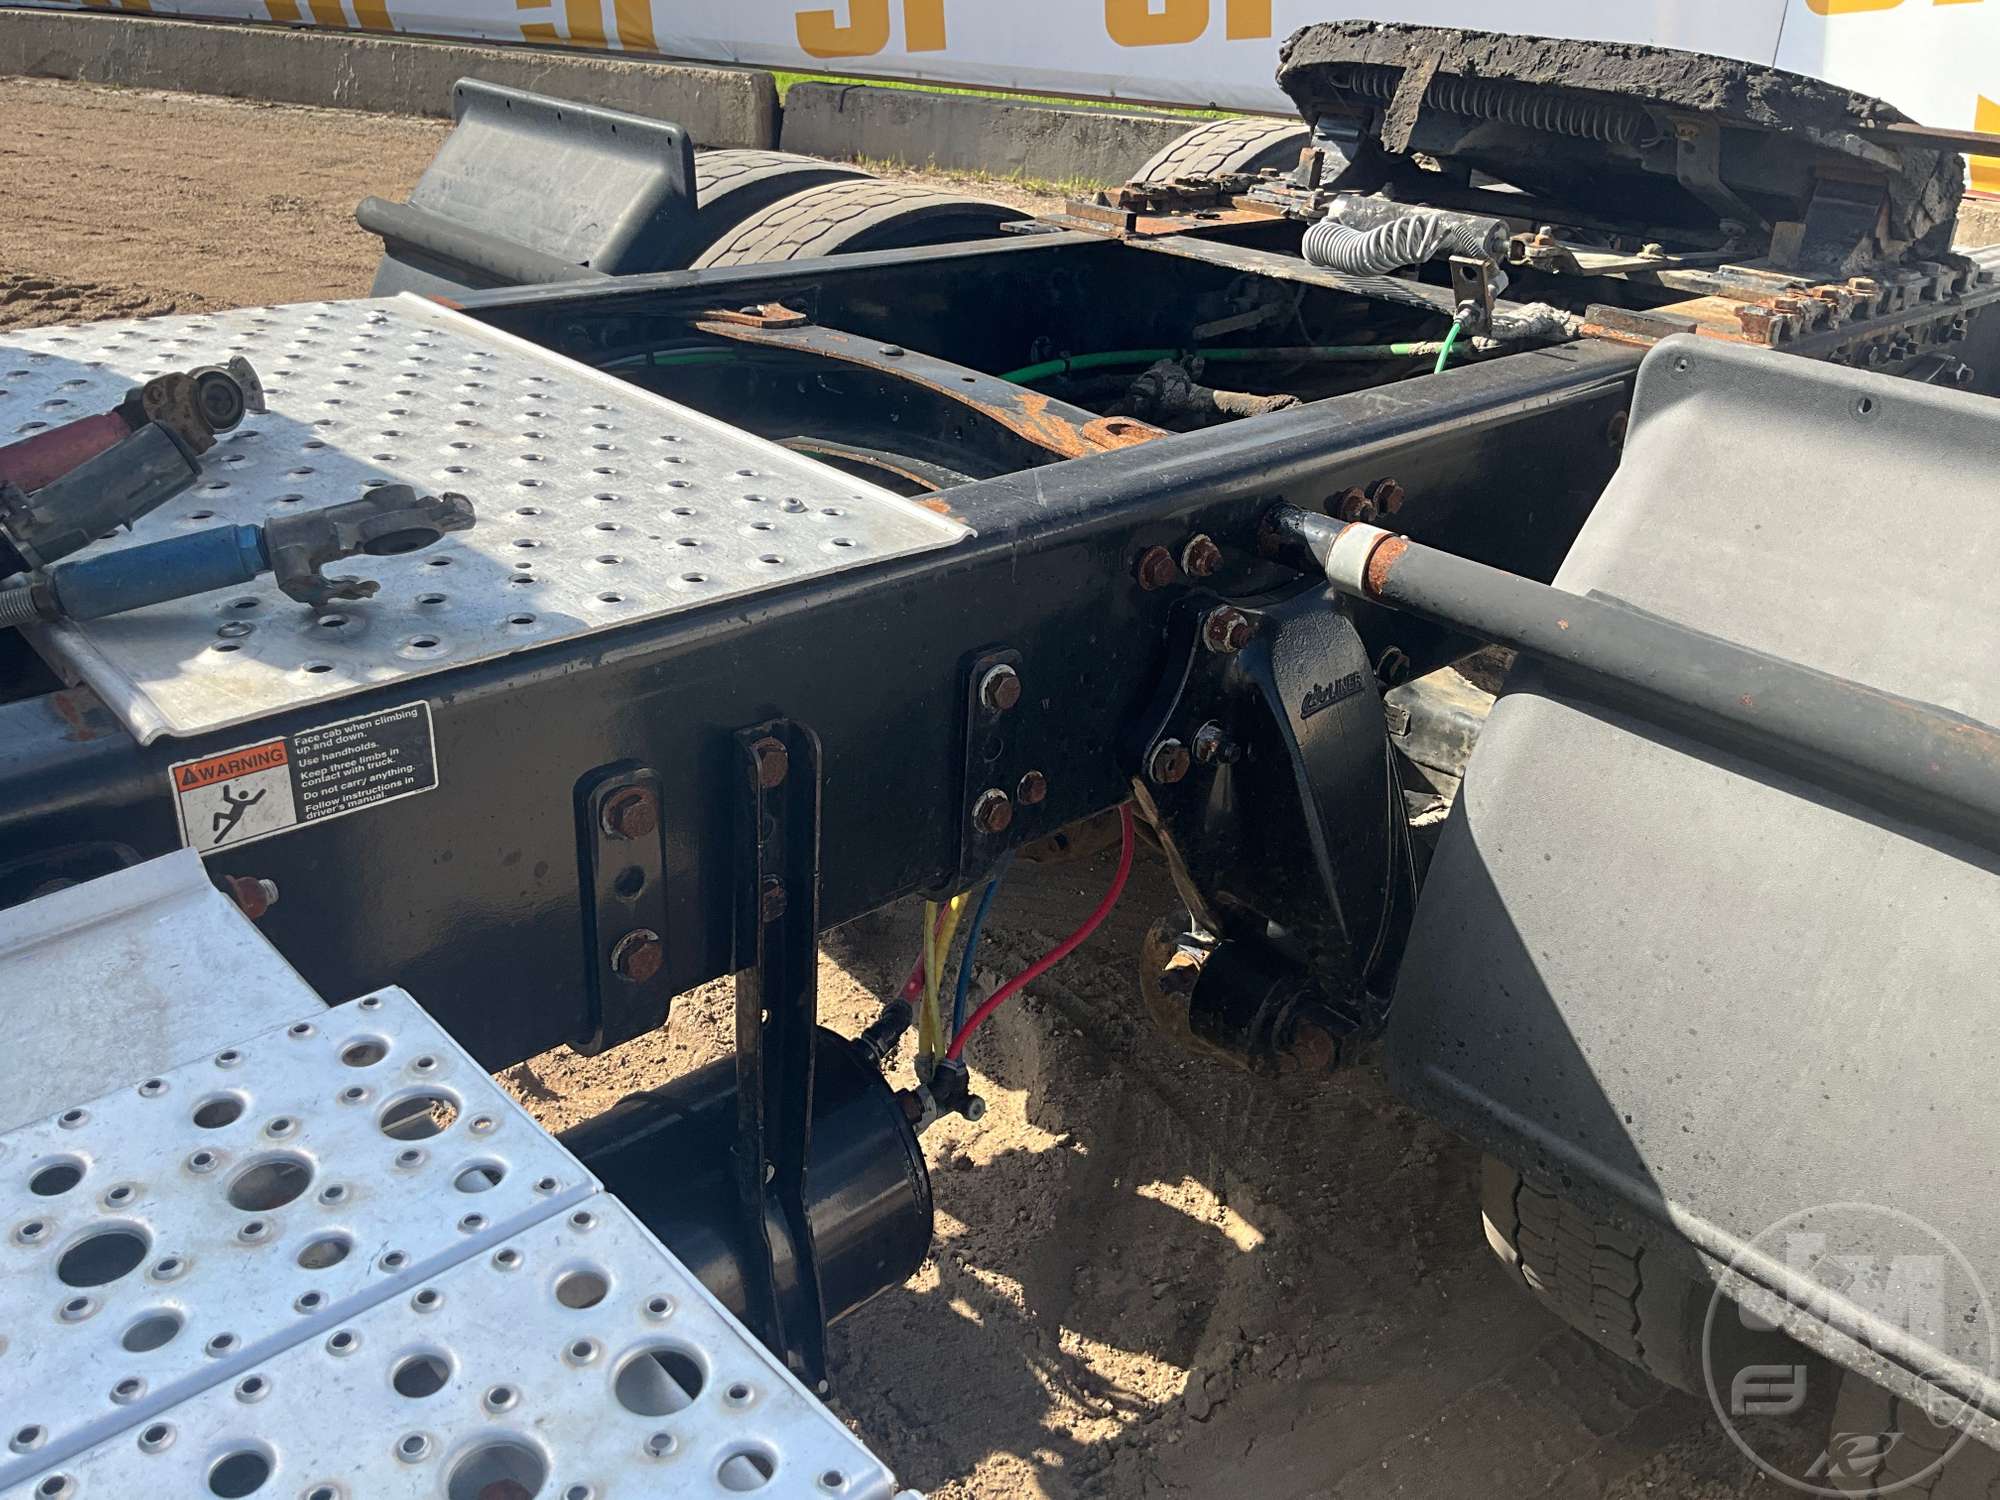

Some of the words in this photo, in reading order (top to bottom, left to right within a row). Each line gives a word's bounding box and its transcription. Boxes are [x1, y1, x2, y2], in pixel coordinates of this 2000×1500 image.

[294, 734, 320, 746] Face
[322, 727, 342, 739] cab
[344, 720, 373, 733] when
[374, 709, 418, 726] climbing
[296, 745, 311, 755] up
[313, 739, 333, 750] and
[335, 731, 368, 743] down.
[198, 748, 284, 777] WARNING
[298, 756, 319, 768] Use
[322, 741, 379, 760] handholds.
[300, 767, 328, 780] Keep
[330, 759, 357, 772] three
[359, 751, 387, 764] limbs
[389, 747, 400, 756] in
[301, 772, 341, 788] contact
[343, 765, 365, 777] with
[367, 757, 396, 770] truck.
[303, 791, 319, 801] Do
[321, 785, 339, 796] not
[340, 777, 367, 790] carry
[369, 764, 416, 782] anything.
[305, 798, 341, 813] Follow
[342, 779, 403, 802] instructions
[404, 776, 415, 785] in
[306, 804, 346, 820] driver's
[347, 791, 388, 808] manual.
